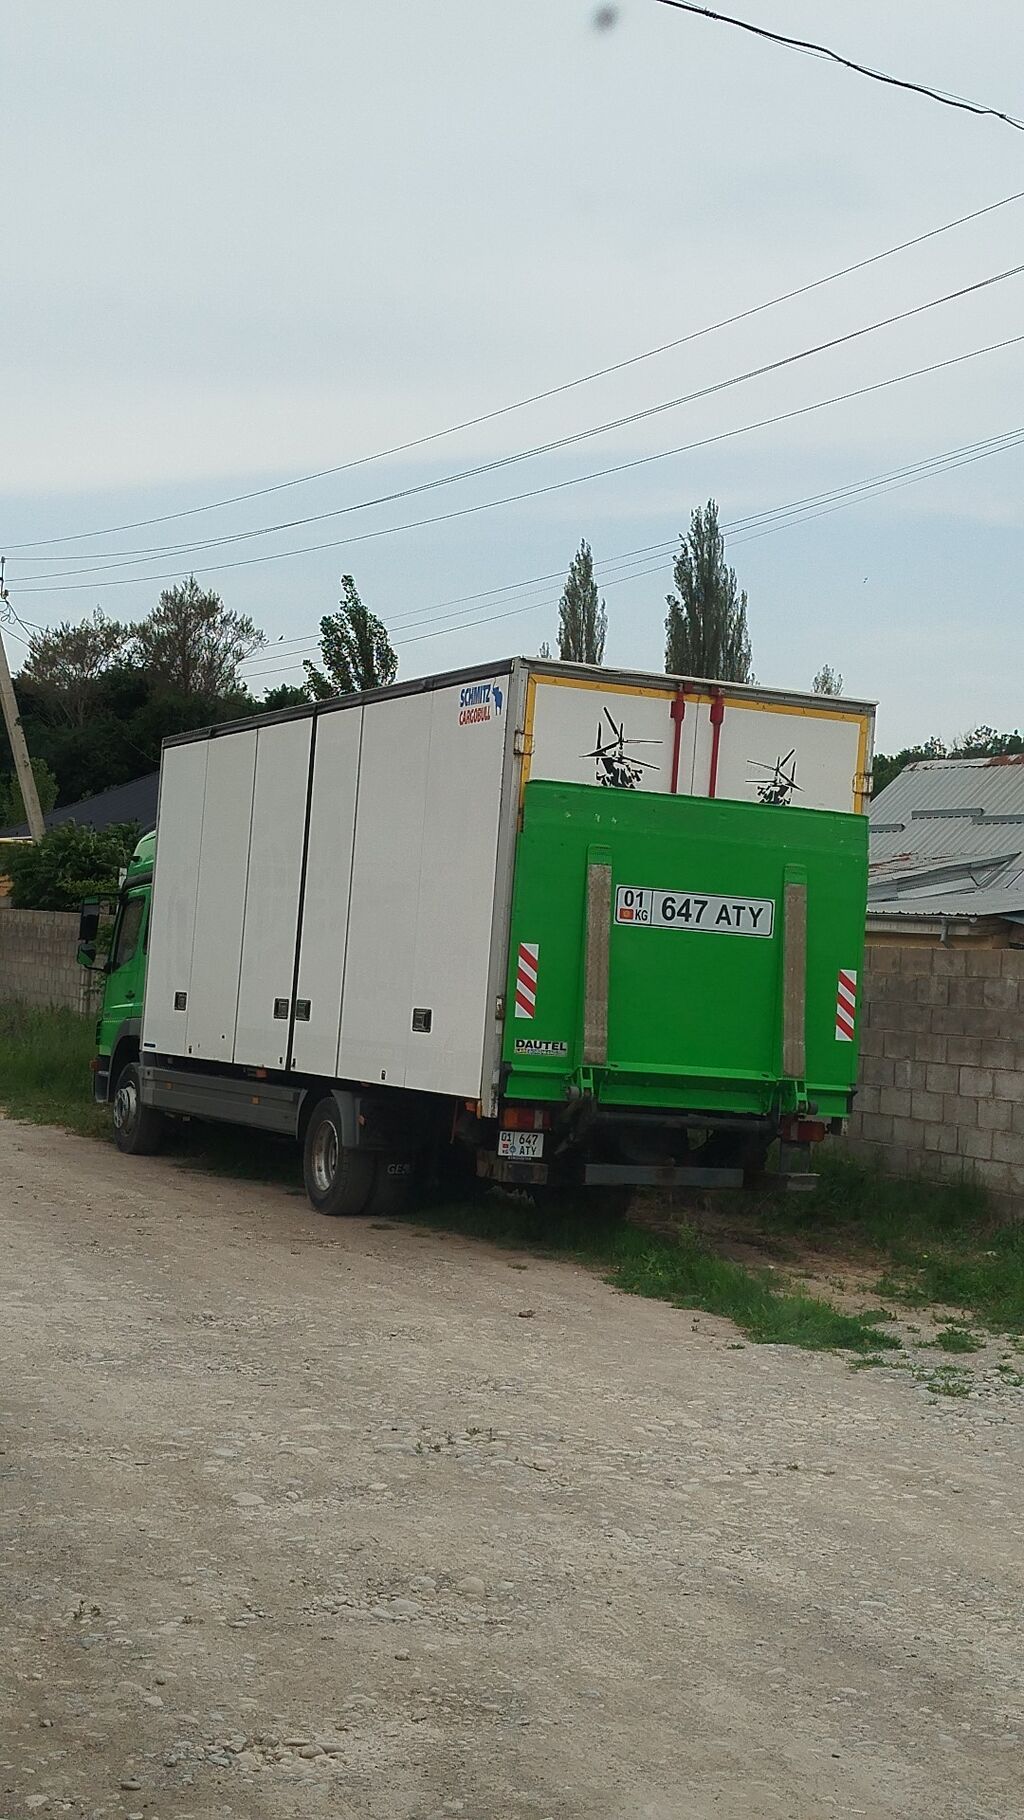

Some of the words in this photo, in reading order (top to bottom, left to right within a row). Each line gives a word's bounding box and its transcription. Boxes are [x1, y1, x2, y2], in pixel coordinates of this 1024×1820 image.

[460, 684, 491, 708] SCHMITZ
[624, 890, 644, 908] 01
[635, 909, 648, 921] KG
[661, 897, 708, 924] 647
[715, 904, 764, 928] ATY
[515, 1039, 567, 1052] DAUTEL
[501, 1132, 511, 1142] 01
[519, 1134, 538, 1146] 647
[519, 1146, 537, 1155] ATY
